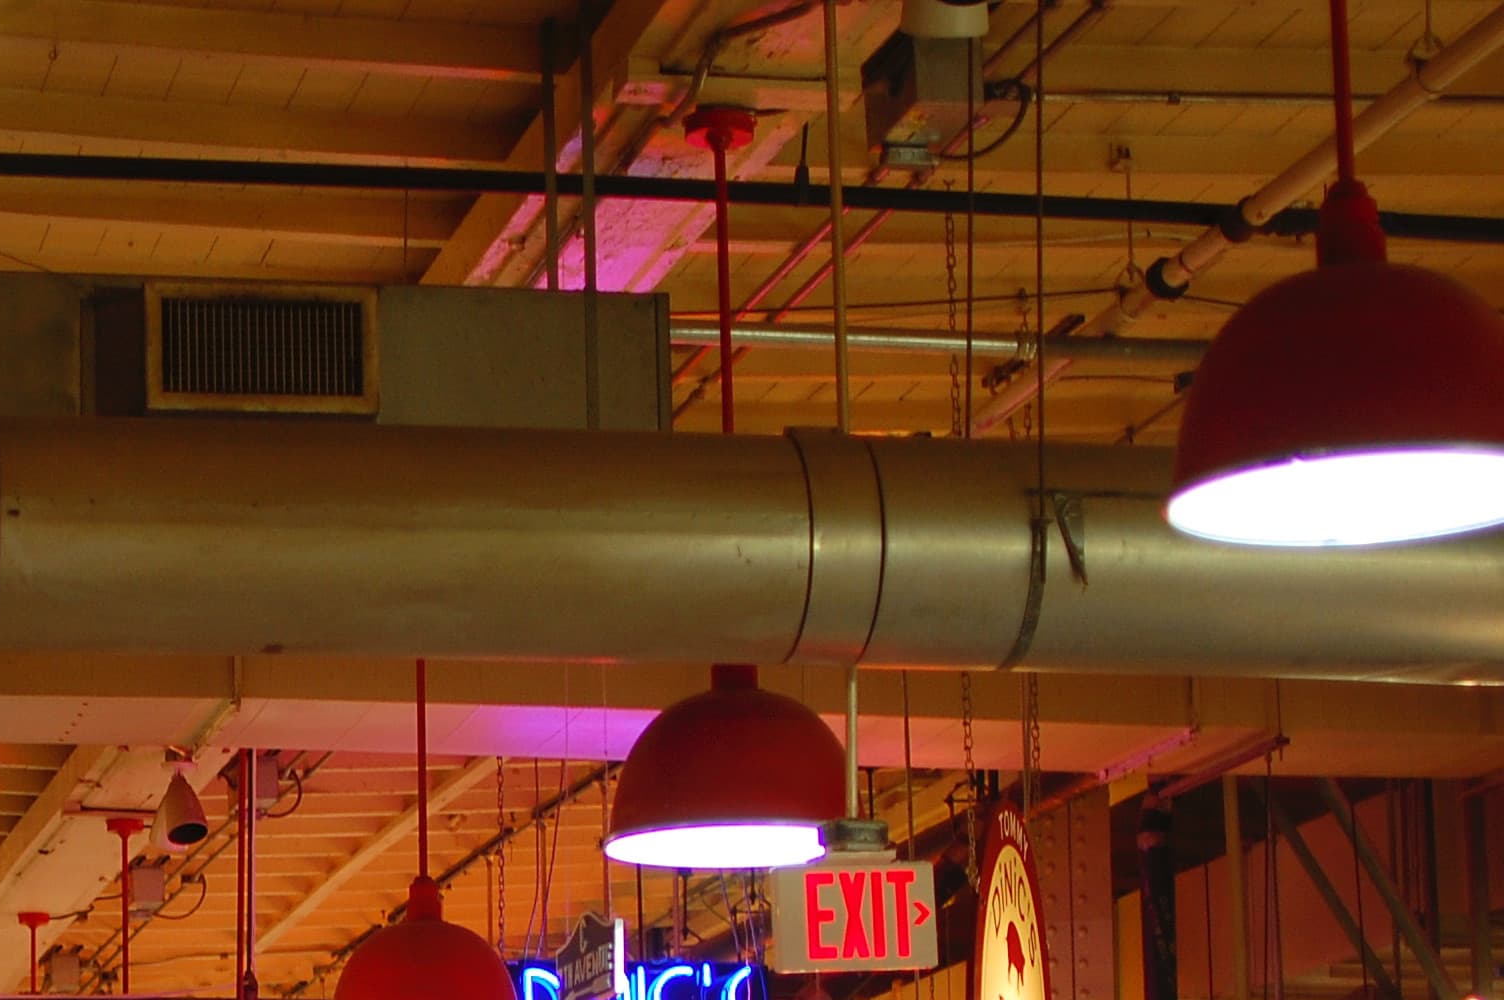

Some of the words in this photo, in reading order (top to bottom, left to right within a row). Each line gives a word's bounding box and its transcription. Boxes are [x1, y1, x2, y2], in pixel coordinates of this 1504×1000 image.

[998, 810, 1029, 862] TOMMY
[804, 869, 916, 960] EXIT
[574, 943, 614, 985] AVENUE
